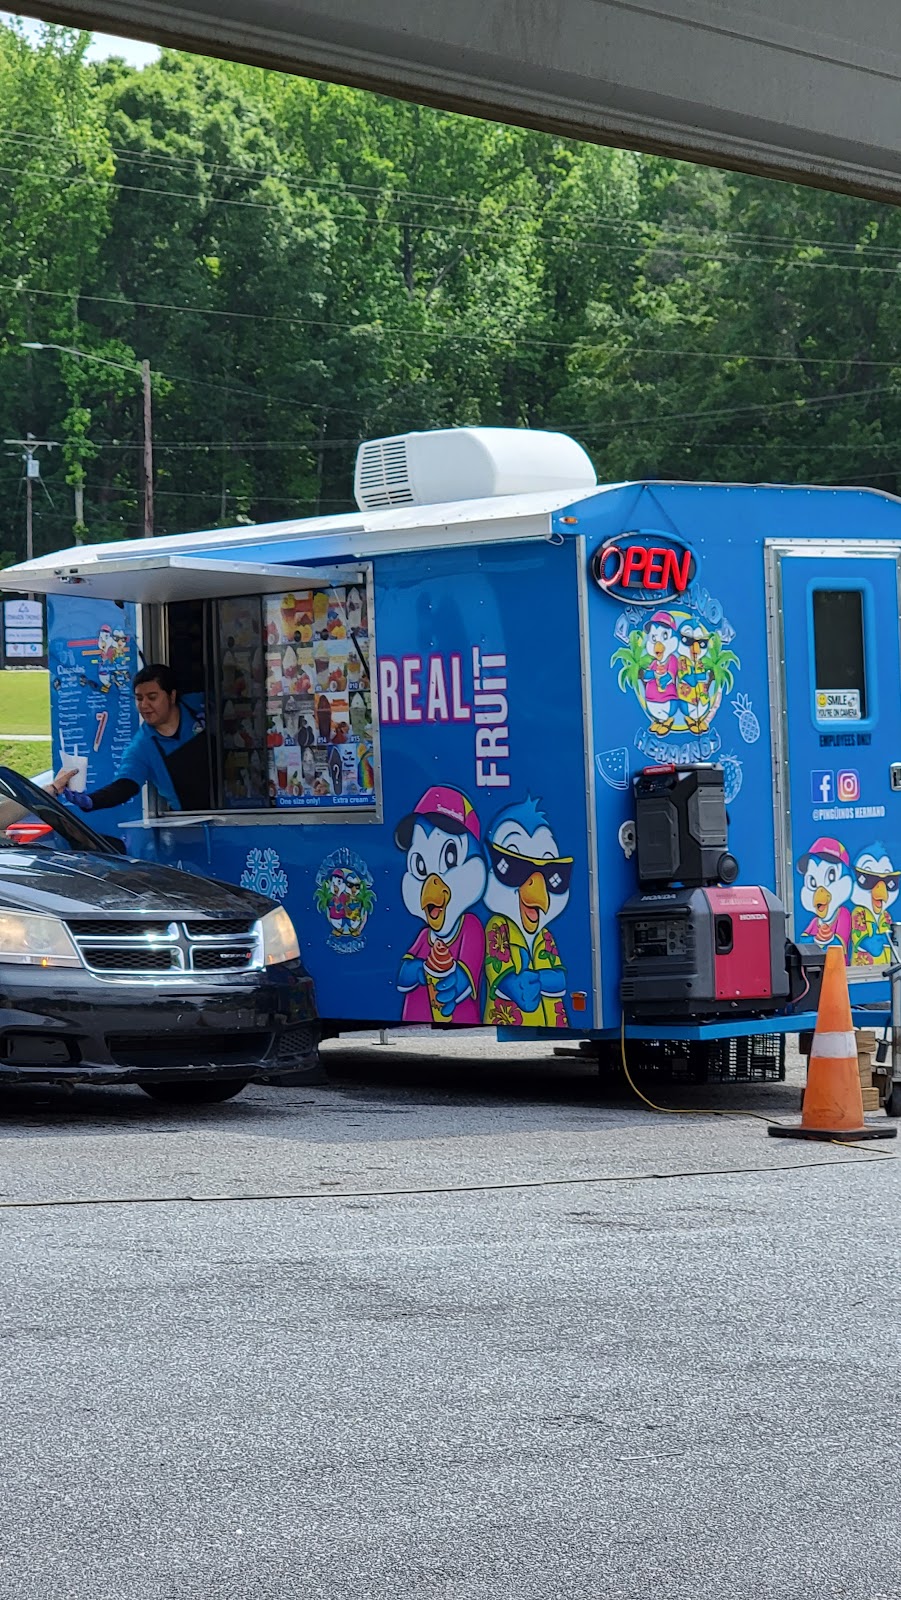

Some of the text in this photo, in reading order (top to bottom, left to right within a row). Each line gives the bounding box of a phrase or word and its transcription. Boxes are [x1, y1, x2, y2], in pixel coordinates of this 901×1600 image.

[597, 546, 692, 592] OPEN
[379, 653, 472, 725] REAL
[827, 695, 847, 706] SMILE
[472, 645, 511, 788] FRUIT
[818, 709, 858, 717] YOU'RE ON CAMERA
[819, 733, 872, 747] EMPLOYEES ONLY
[279, 797, 292, 805] One
[292, 797, 305, 805] size
[305, 797, 321, 806] only!
[333, 796, 348, 804] Extra
[854, 806, 886, 819] HERMANO
[640, 892, 677, 901] HONDA
[739, 912, 768, 921] HONDA
